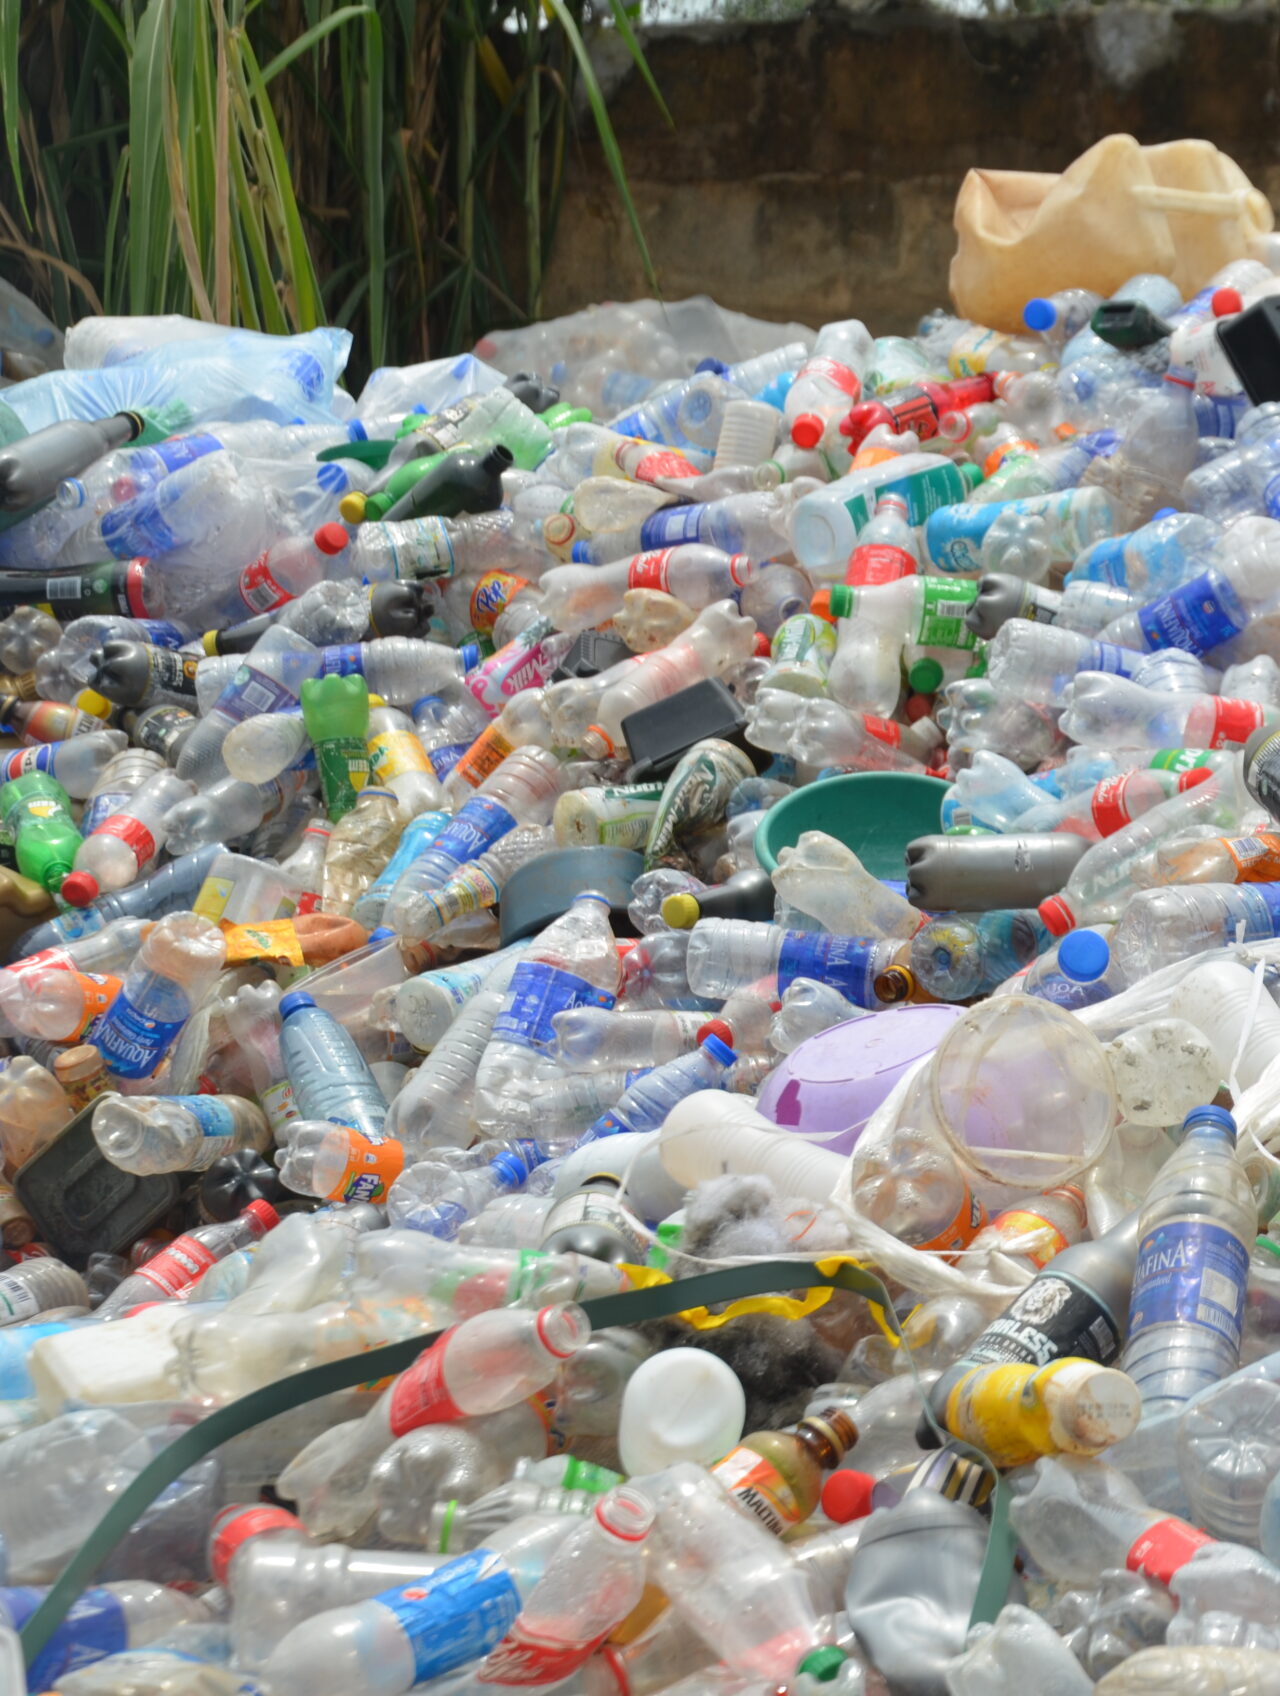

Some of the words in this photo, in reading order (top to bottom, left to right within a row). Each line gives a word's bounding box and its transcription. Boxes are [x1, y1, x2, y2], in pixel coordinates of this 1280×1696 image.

[505, 655, 550, 693] Milk
[432, 750, 460, 769] FINA
[609, 781, 666, 797] Nutri
[444, 817, 486, 851] AQUAF
[826, 932, 850, 967] AFINA
[94, 1019, 157, 1069] AQUAFINA
[1134, 1239, 1187, 1285] UAFINA
